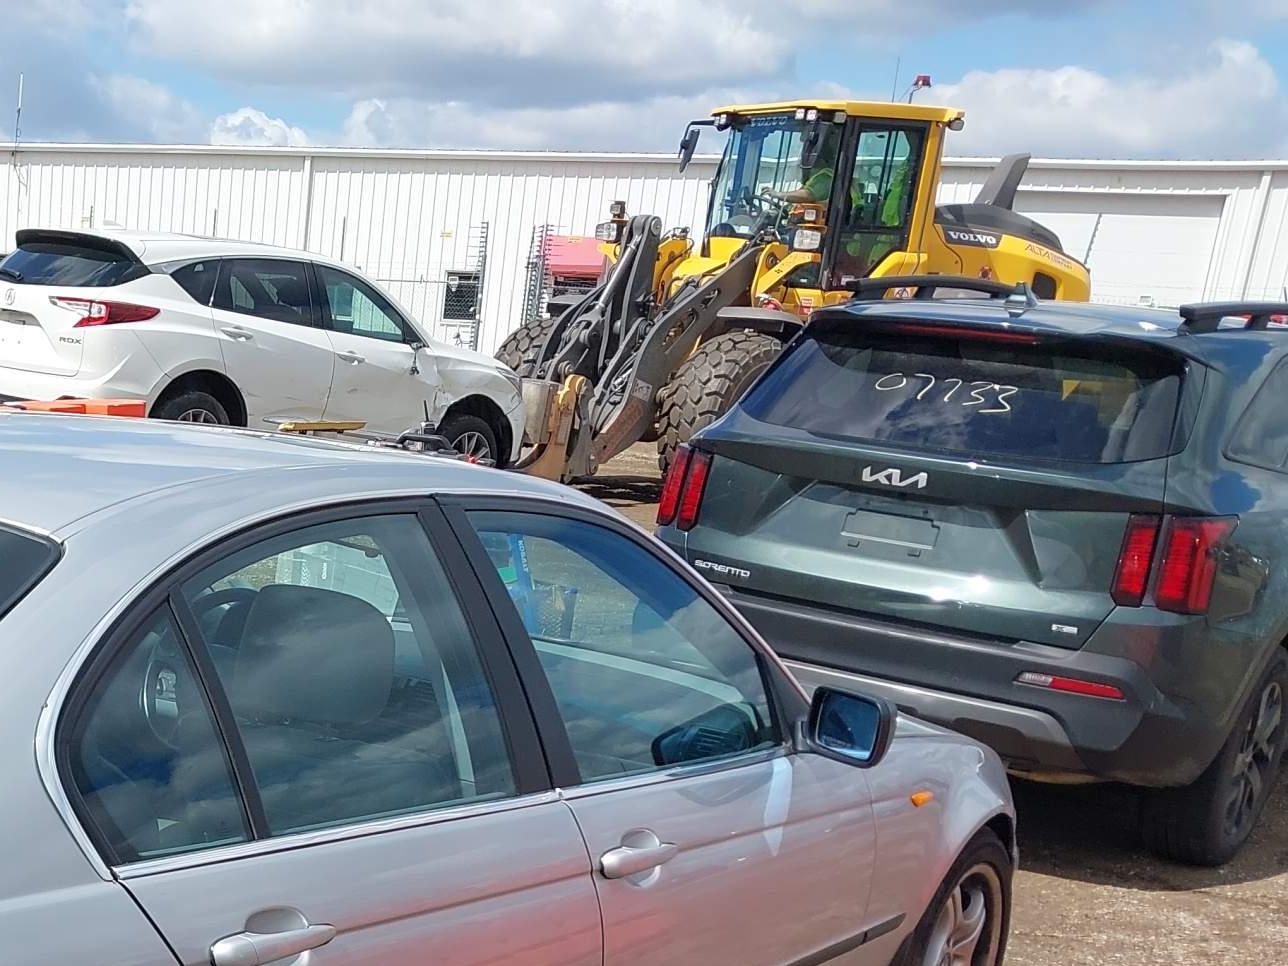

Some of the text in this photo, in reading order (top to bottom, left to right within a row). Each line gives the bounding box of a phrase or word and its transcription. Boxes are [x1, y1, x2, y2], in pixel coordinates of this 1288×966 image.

[948, 230, 997, 244] VOLVO
[1024, 243, 1051, 259] ALTA
[58, 336, 83, 345] RDX
[875, 372, 1019, 413] 07733
[862, 465, 929, 489] KIA
[517, 540, 529, 573] KOBALT
[694, 559, 752, 577] SORENTO
